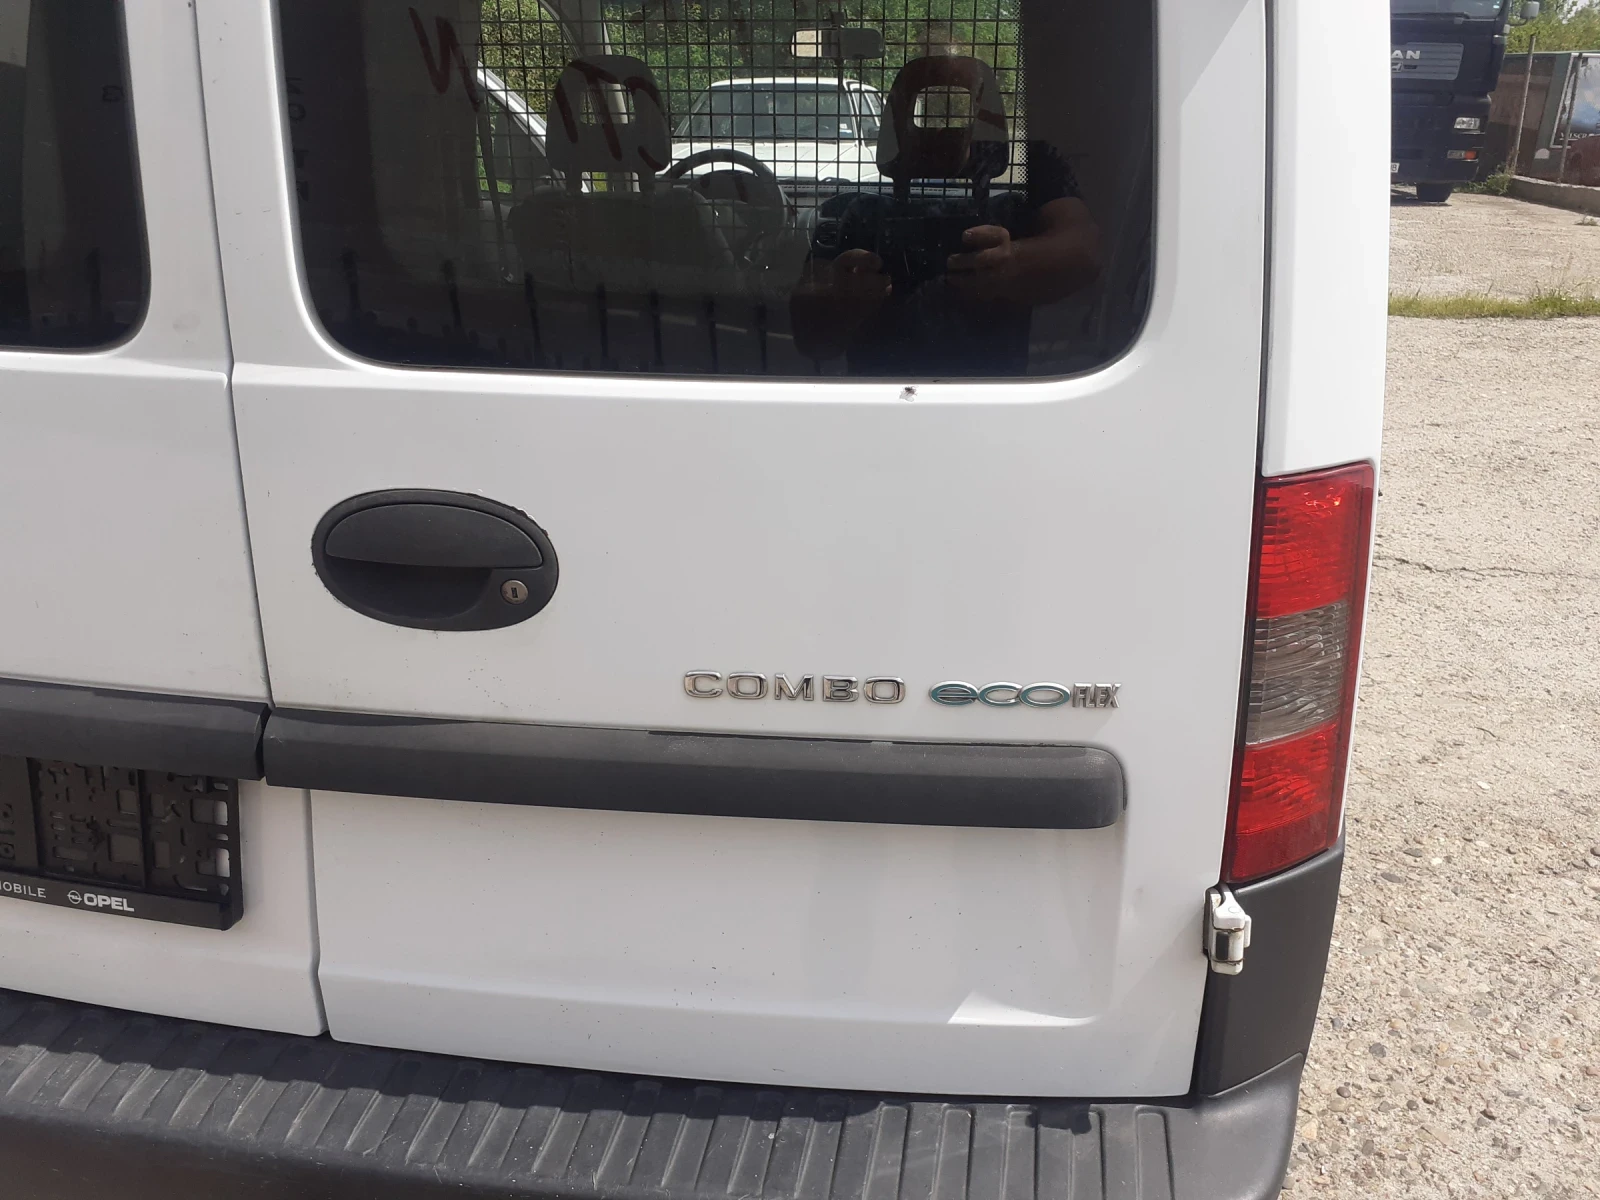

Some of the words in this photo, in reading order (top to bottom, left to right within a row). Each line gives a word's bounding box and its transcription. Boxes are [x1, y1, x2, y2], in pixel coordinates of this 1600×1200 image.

[1391, 49, 1420, 60] AN
[683, 670, 906, 704] COMBO
[0, 881, 46, 898] OBILE
[83, 892, 135, 912] OPEL
